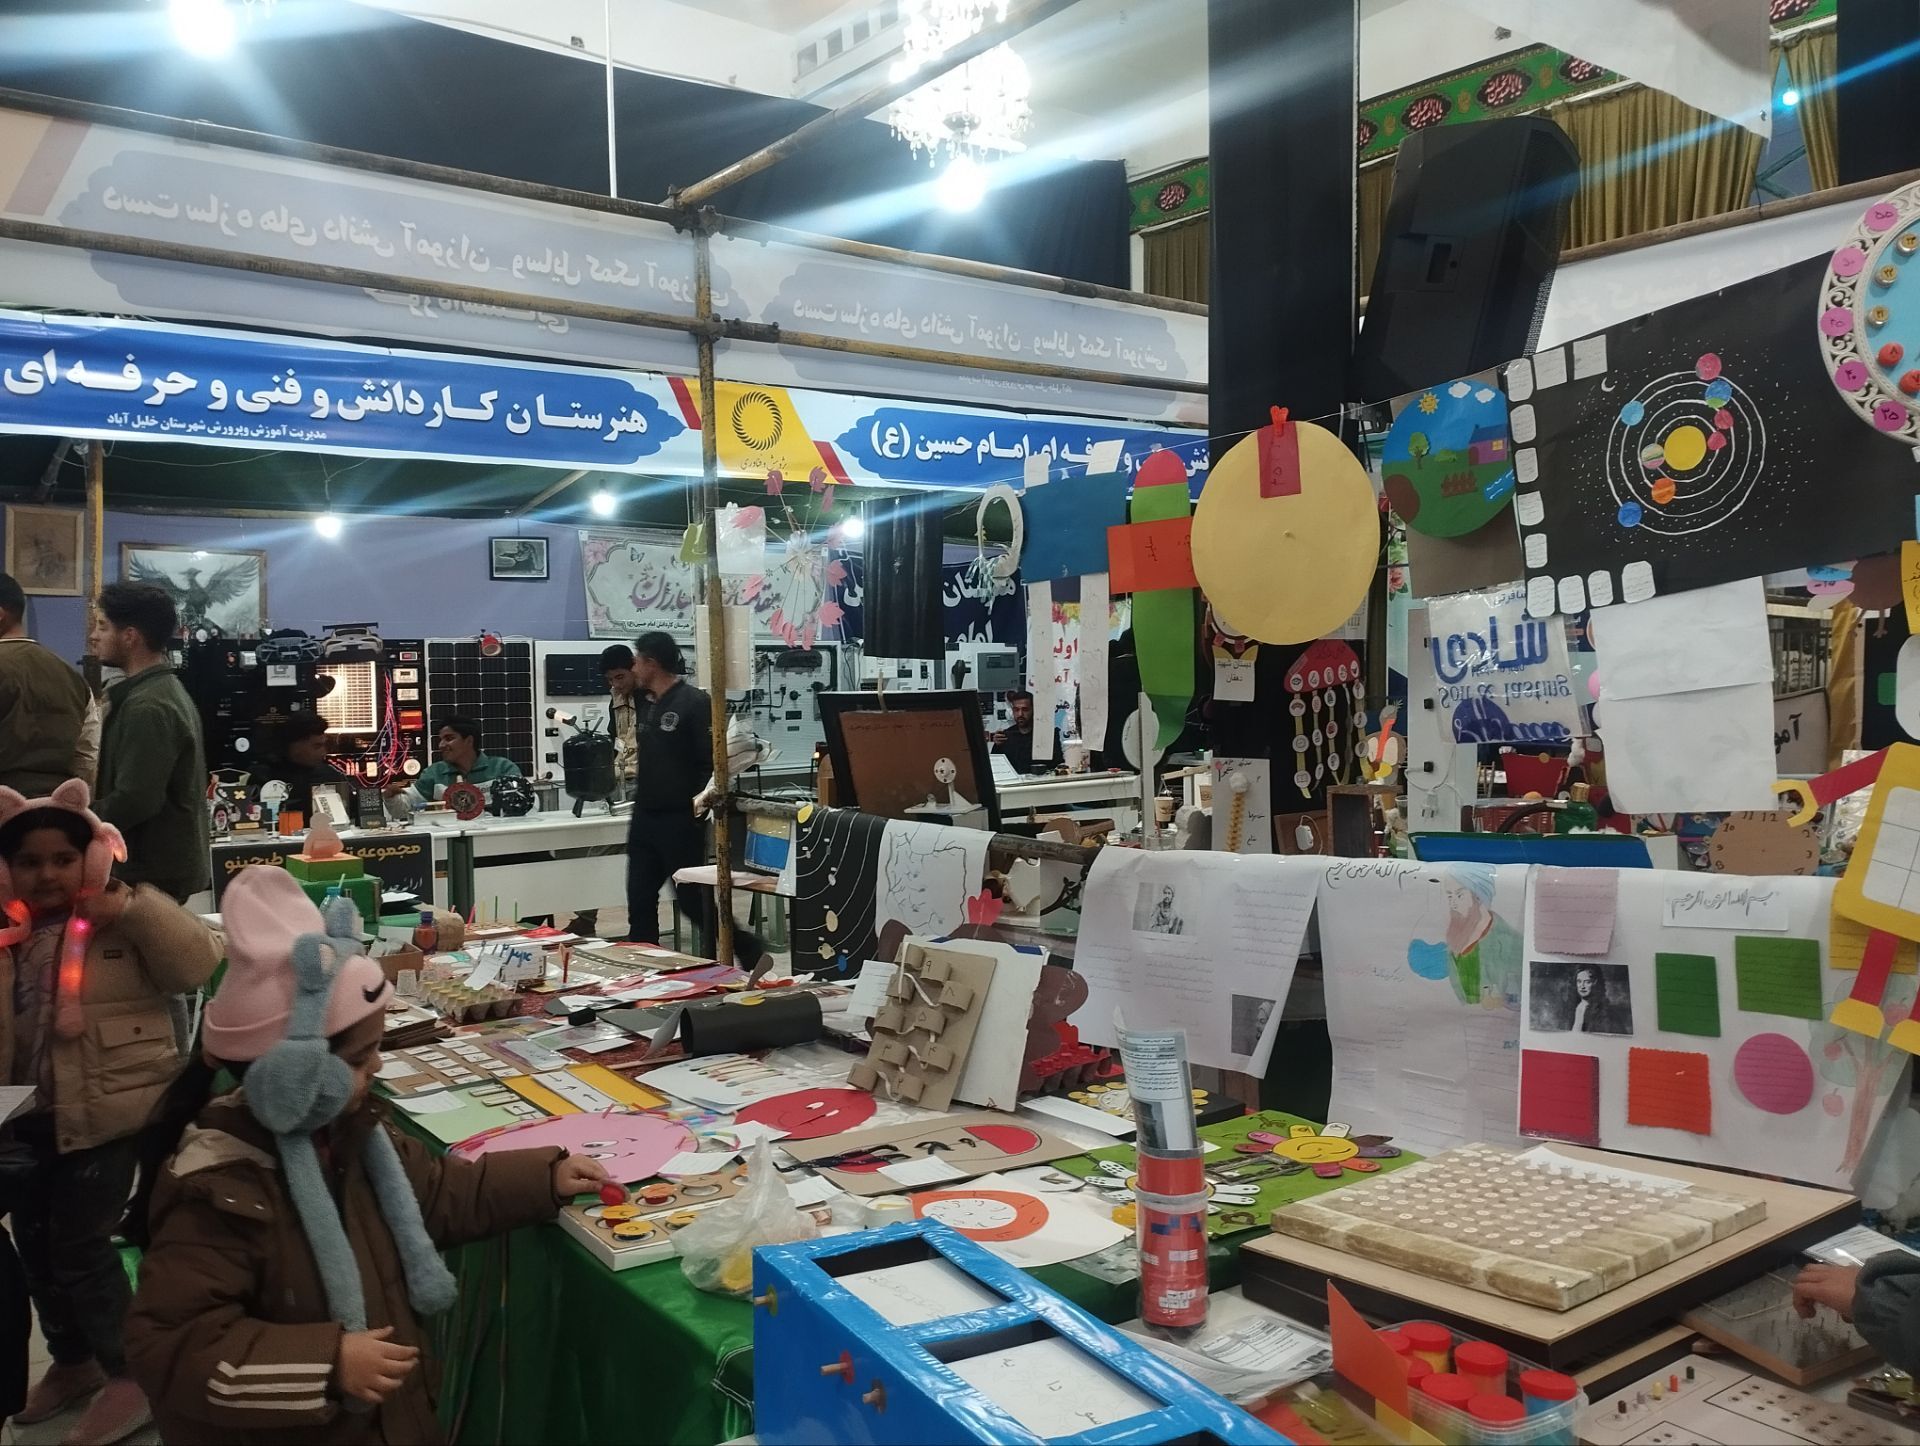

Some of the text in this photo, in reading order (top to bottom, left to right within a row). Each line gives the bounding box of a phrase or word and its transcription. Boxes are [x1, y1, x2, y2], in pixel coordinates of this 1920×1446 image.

[4, 349, 58, 395] ای
[65, 353, 198, 405] حرفه
[207, 379, 228, 410] و
[236, 368, 302, 413] فنی
[310, 388, 329, 418] و
[107, 411, 129, 425] آباد
[131, 414, 158, 429] خلیل
[161, 417, 205, 432] شهرستان
[251, 423, 287, 439] آموزش
[289, 424, 327, 440] مدیریت
[505, 394, 648, 441] هنرستان
[871, 420, 911, 459] (ع)
[915, 434, 972, 462] حسین
[977, 431, 1028, 464] امام
[1432, 608, 1548, 684] شادی
[357, 843, 421, 862] مجموعه
